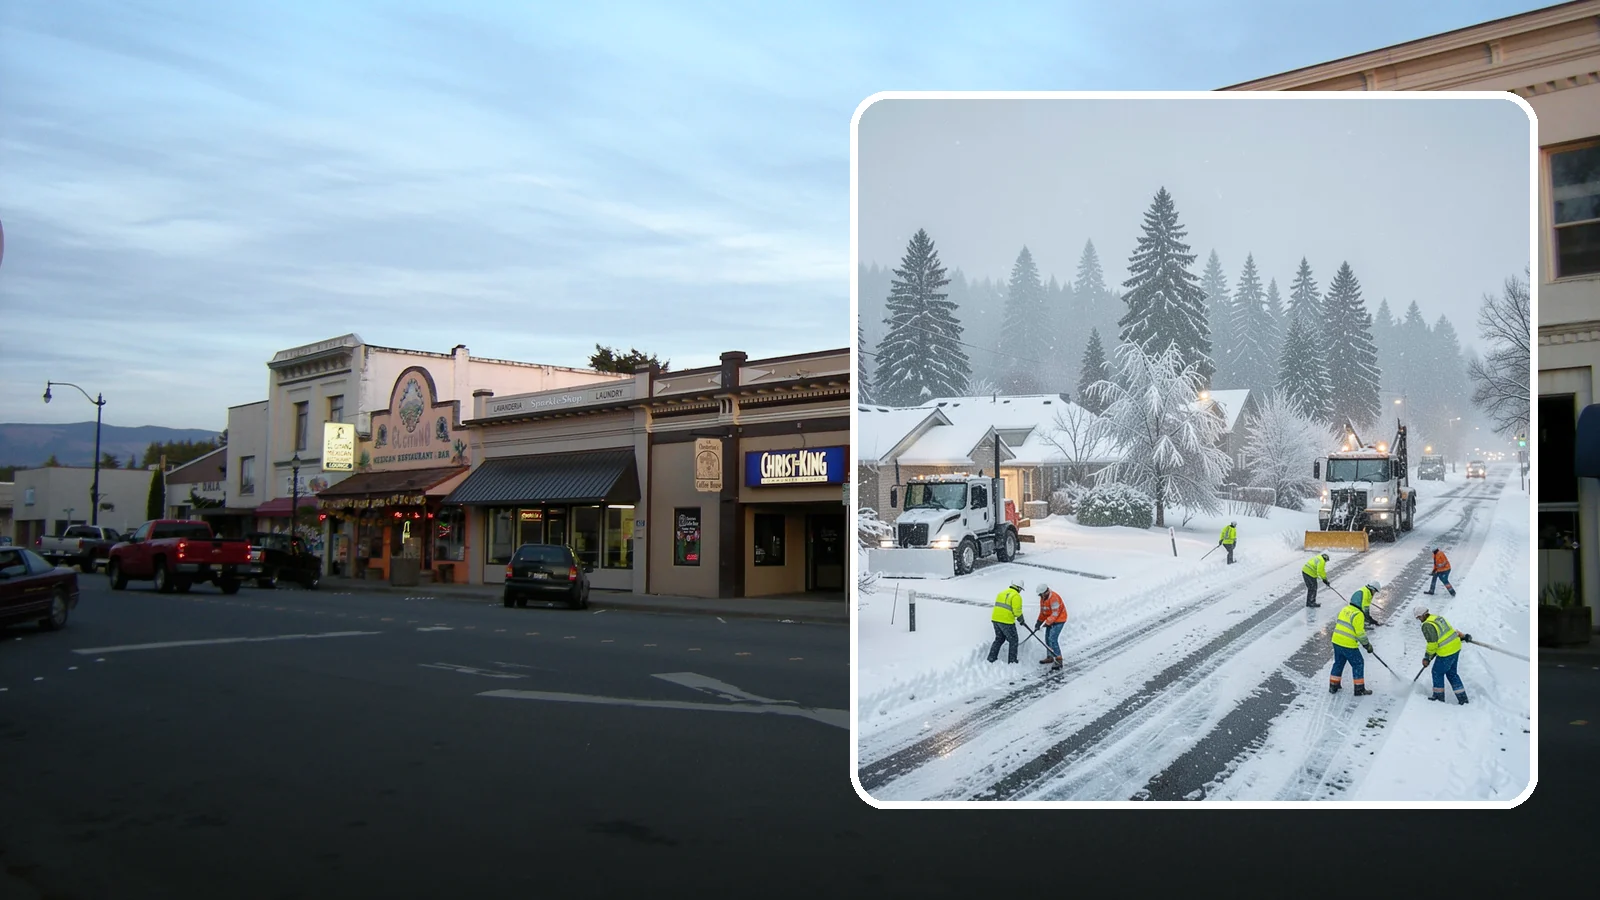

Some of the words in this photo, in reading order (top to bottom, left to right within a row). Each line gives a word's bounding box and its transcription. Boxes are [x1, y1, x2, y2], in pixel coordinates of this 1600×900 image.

[493, 402, 522, 413] LAVANDERIA
[561, 394, 583, 405] Shop
[595, 389, 624, 400] LAUNDRY
[391, 425, 402, 449] EL
[373, 455, 396, 464] MEXICAN
[397, 451, 434, 462] RESTAURANT
[438, 450, 450, 459] BAR
[760, 452, 797, 478] CHRIST
[799, 450, 827, 477] KING
[697, 481, 709, 489] Coffee
[710, 481, 722, 489] House
